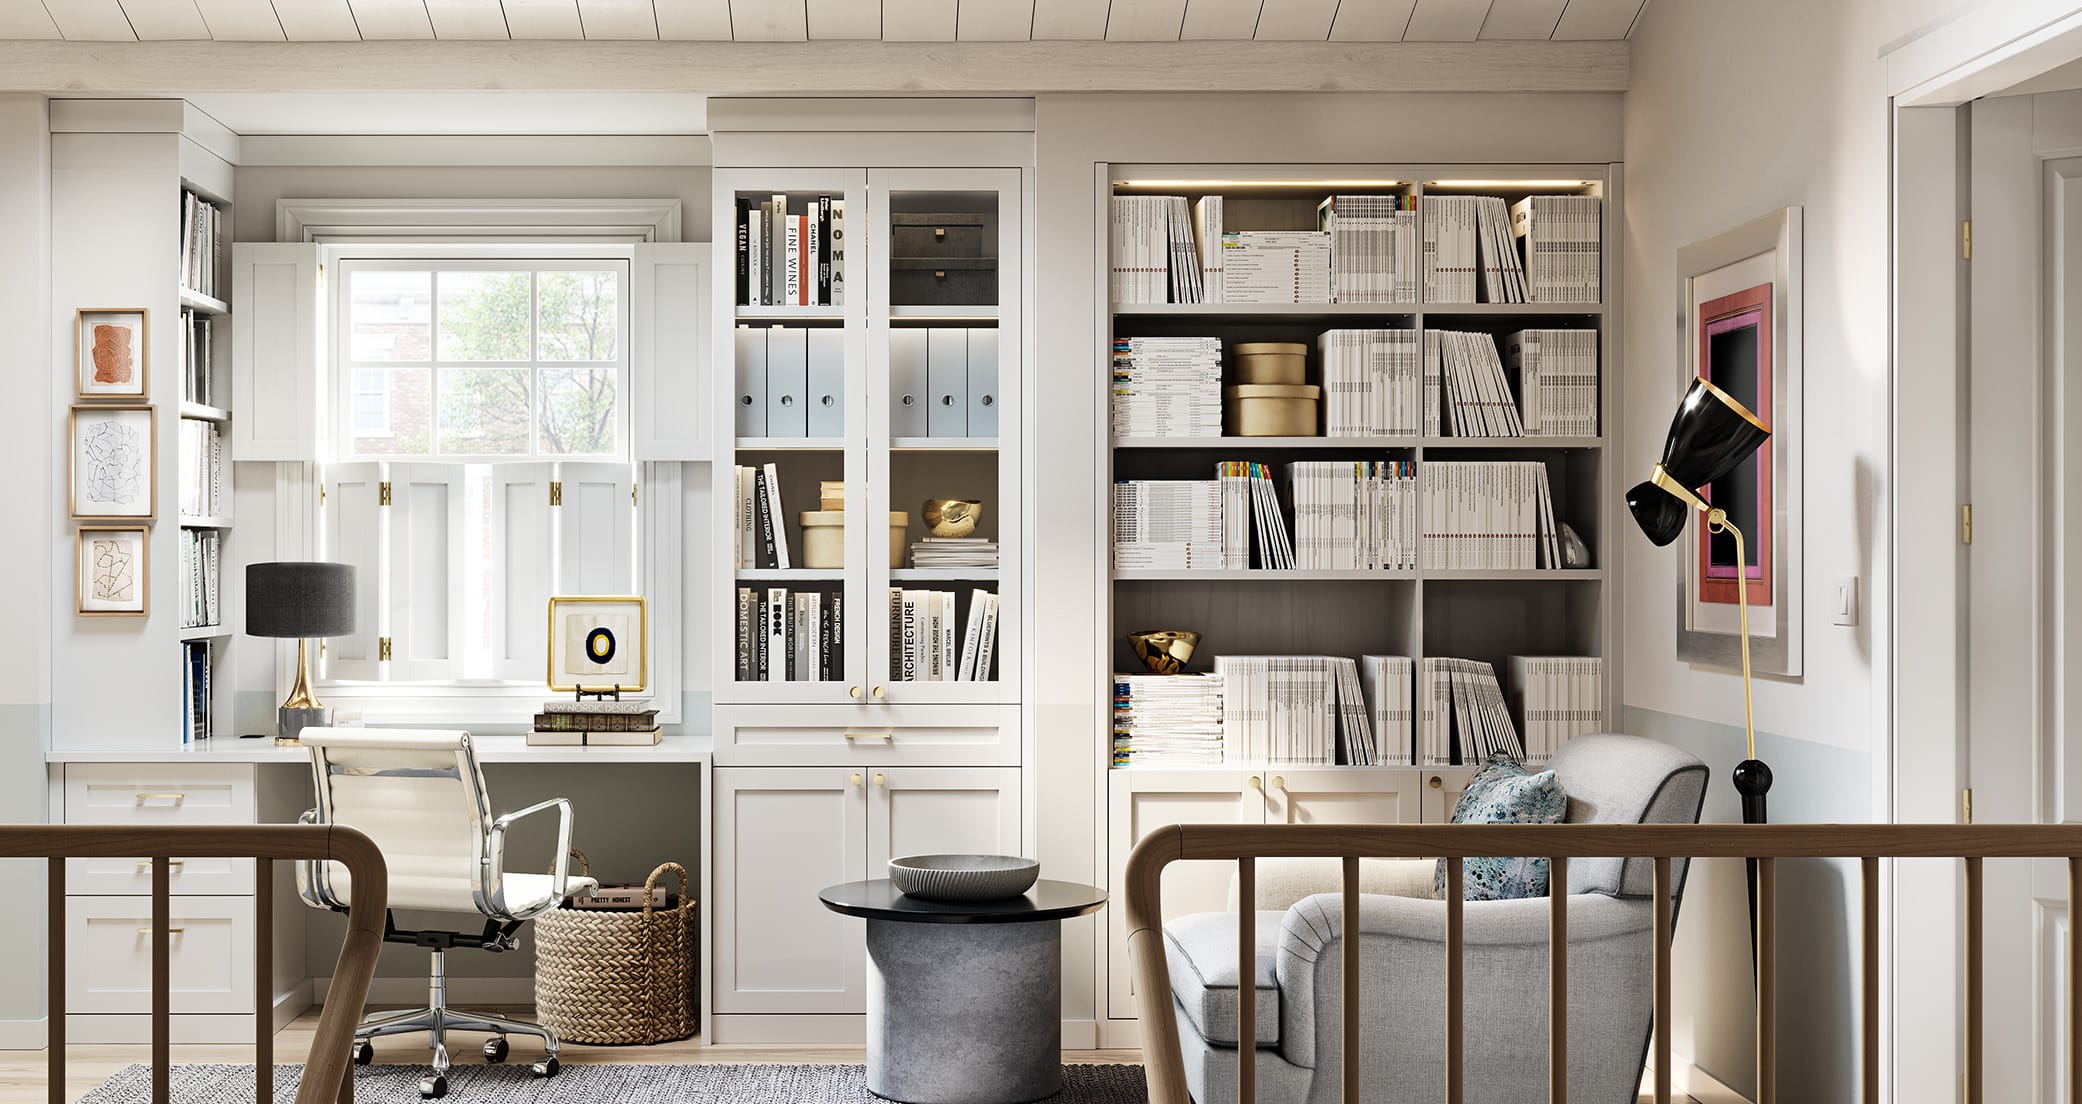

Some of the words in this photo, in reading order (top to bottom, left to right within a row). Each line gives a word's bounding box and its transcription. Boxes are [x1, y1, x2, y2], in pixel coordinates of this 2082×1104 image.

[739, 223, 747, 252] VEGAN
[788, 227, 797, 253] FINE
[833, 208, 843, 283] NOMA
[788, 257, 797, 296] WINES
[760, 486, 769, 514] TAILORED
[740, 593, 748, 649] DOMESTIC
[774, 604, 782, 636] BOOK
[892, 591, 900, 655] FURNITURE
[984, 614, 993, 649] BLUEPRINTS
[740, 650, 748, 671] ART
[967, 627, 977, 661] KINFOLK
[545, 703, 565, 712] NEW
[568, 703, 601, 712] NORDIC
[606, 703, 638, 712] DESIGN
